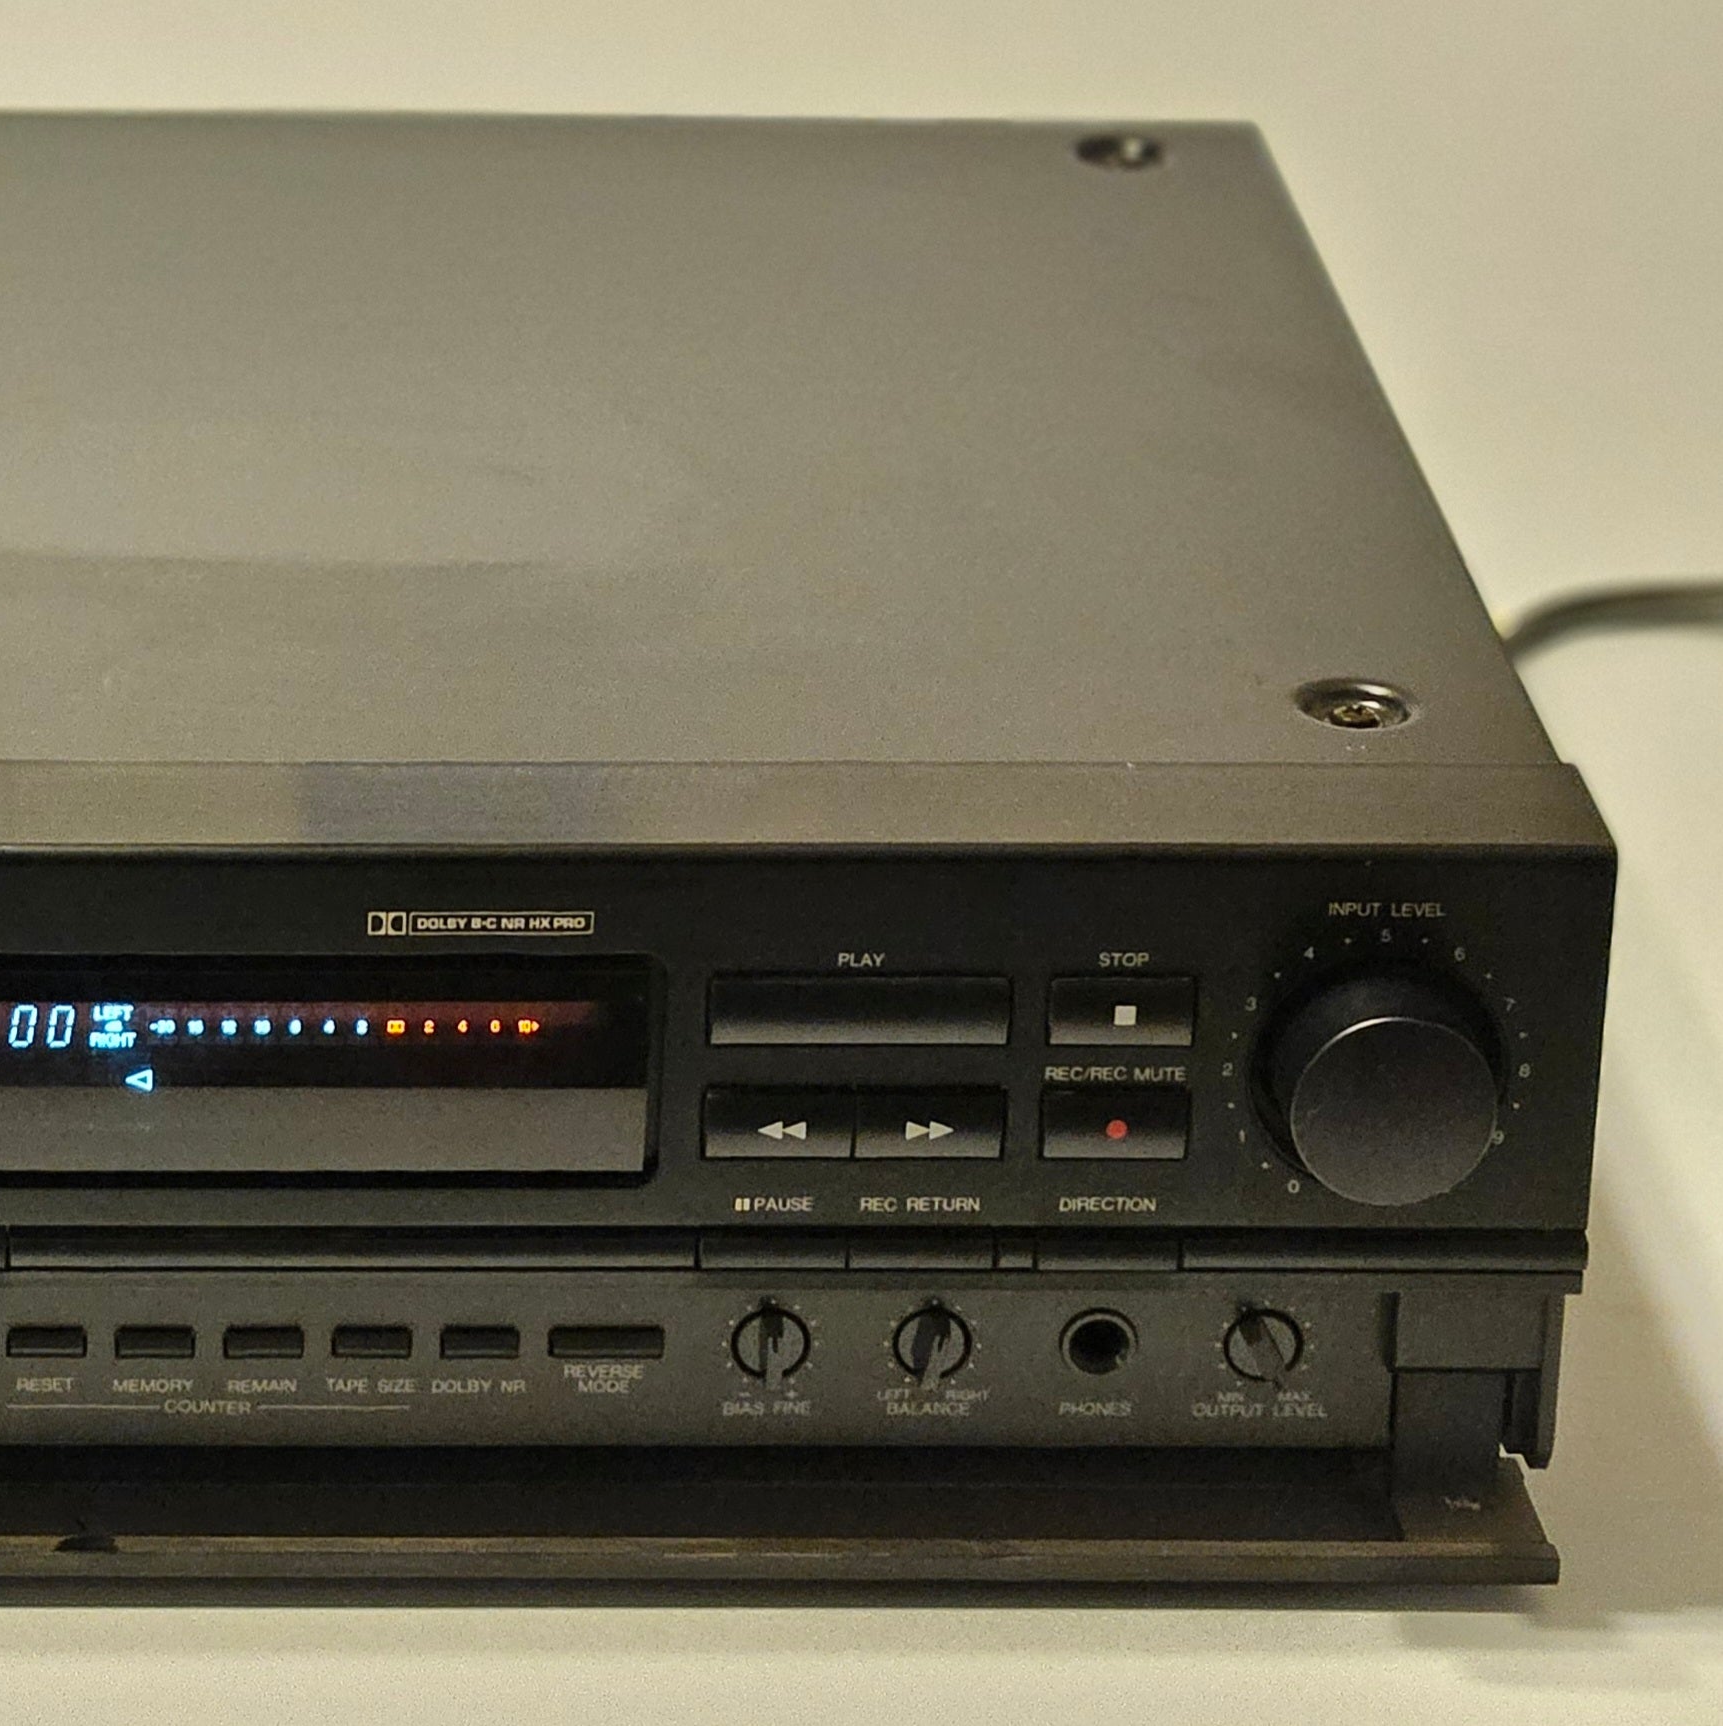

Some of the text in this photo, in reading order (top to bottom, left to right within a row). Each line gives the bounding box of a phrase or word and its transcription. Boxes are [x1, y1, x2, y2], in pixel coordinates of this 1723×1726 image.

[1328, 902, 1446, 918] INPUT LEVEL
[416, 917, 468, 930] DOLBY
[500, 917, 526, 930] NR
[528, 917, 552, 930] HX
[553, 917, 586, 929] PRO
[1381, 929, 1392, 943] 5
[837, 952, 885, 968] PLAY
[1098, 952, 1150, 969] STOP
[1303, 946, 1316, 960] 4
[1454, 947, 1466, 962] 6
[1244, 996, 1257, 1012] 3
[92, 1004, 134, 1021] LEFT
[423, 1019, 435, 1035] 2
[457, 1019, 468, 1034] 4
[89, 1031, 137, 1048] RIGHT
[1045, 1066, 1185, 1082] REC/REC MUTE
[1222, 1063, 1234, 1077] 2
[1519, 1063, 1531, 1078] 8
[1287, 1180, 1300, 1193] 0
[753, 1196, 813, 1212] PAUSE
[860, 1197, 980, 1212] REC RETURN
[1059, 1197, 1156, 1212] DIRECTION
[564, 1364, 644, 1379] REVERSE
[16, 1378, 73, 1392] RESET
[112, 1378, 193, 1393] MEMORY
[228, 1379, 297, 1393] REMAIN
[327, 1378, 416, 1393] TAPE SIZE
[432, 1379, 526, 1393] DOLBY NR
[578, 1379, 630, 1393] MODE
[878, 1388, 909, 1400] LEFT
[946, 1389, 987, 1401] RIGHT
[164, 1400, 251, 1415] COUNTER
[722, 1401, 811, 1416] BIAS FINE
[887, 1402, 970, 1416] BALANCE
[1059, 1402, 1131, 1416] PHONES
[1192, 1403, 1327, 1418] OUTPUT LEVEL
